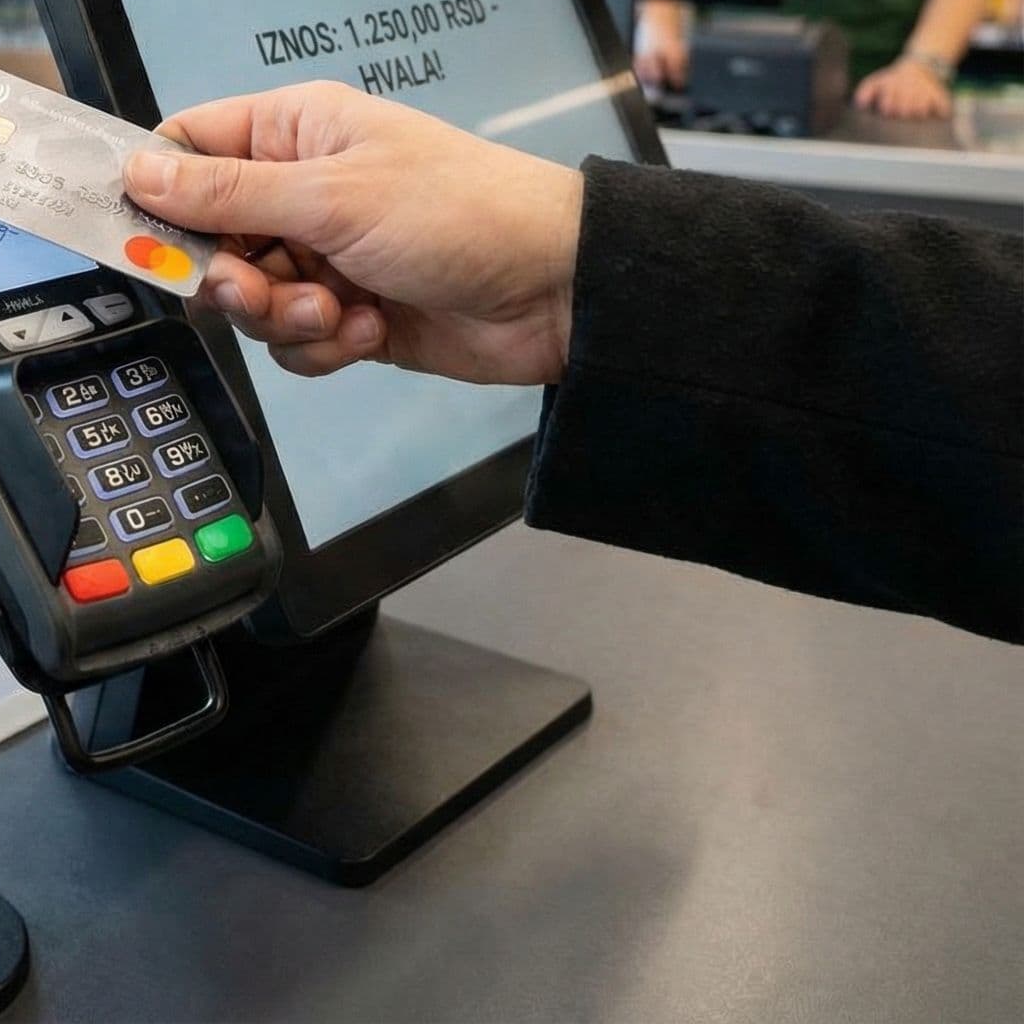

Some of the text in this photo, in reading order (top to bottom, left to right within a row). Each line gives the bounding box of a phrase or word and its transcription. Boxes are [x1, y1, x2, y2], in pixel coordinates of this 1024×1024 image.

[255, 22, 343, 66] IZNOS:
[344, 3, 440, 49] 1.250,00
[358, 49, 446, 95] HVALA!
[126, 508, 145, 529] 0
